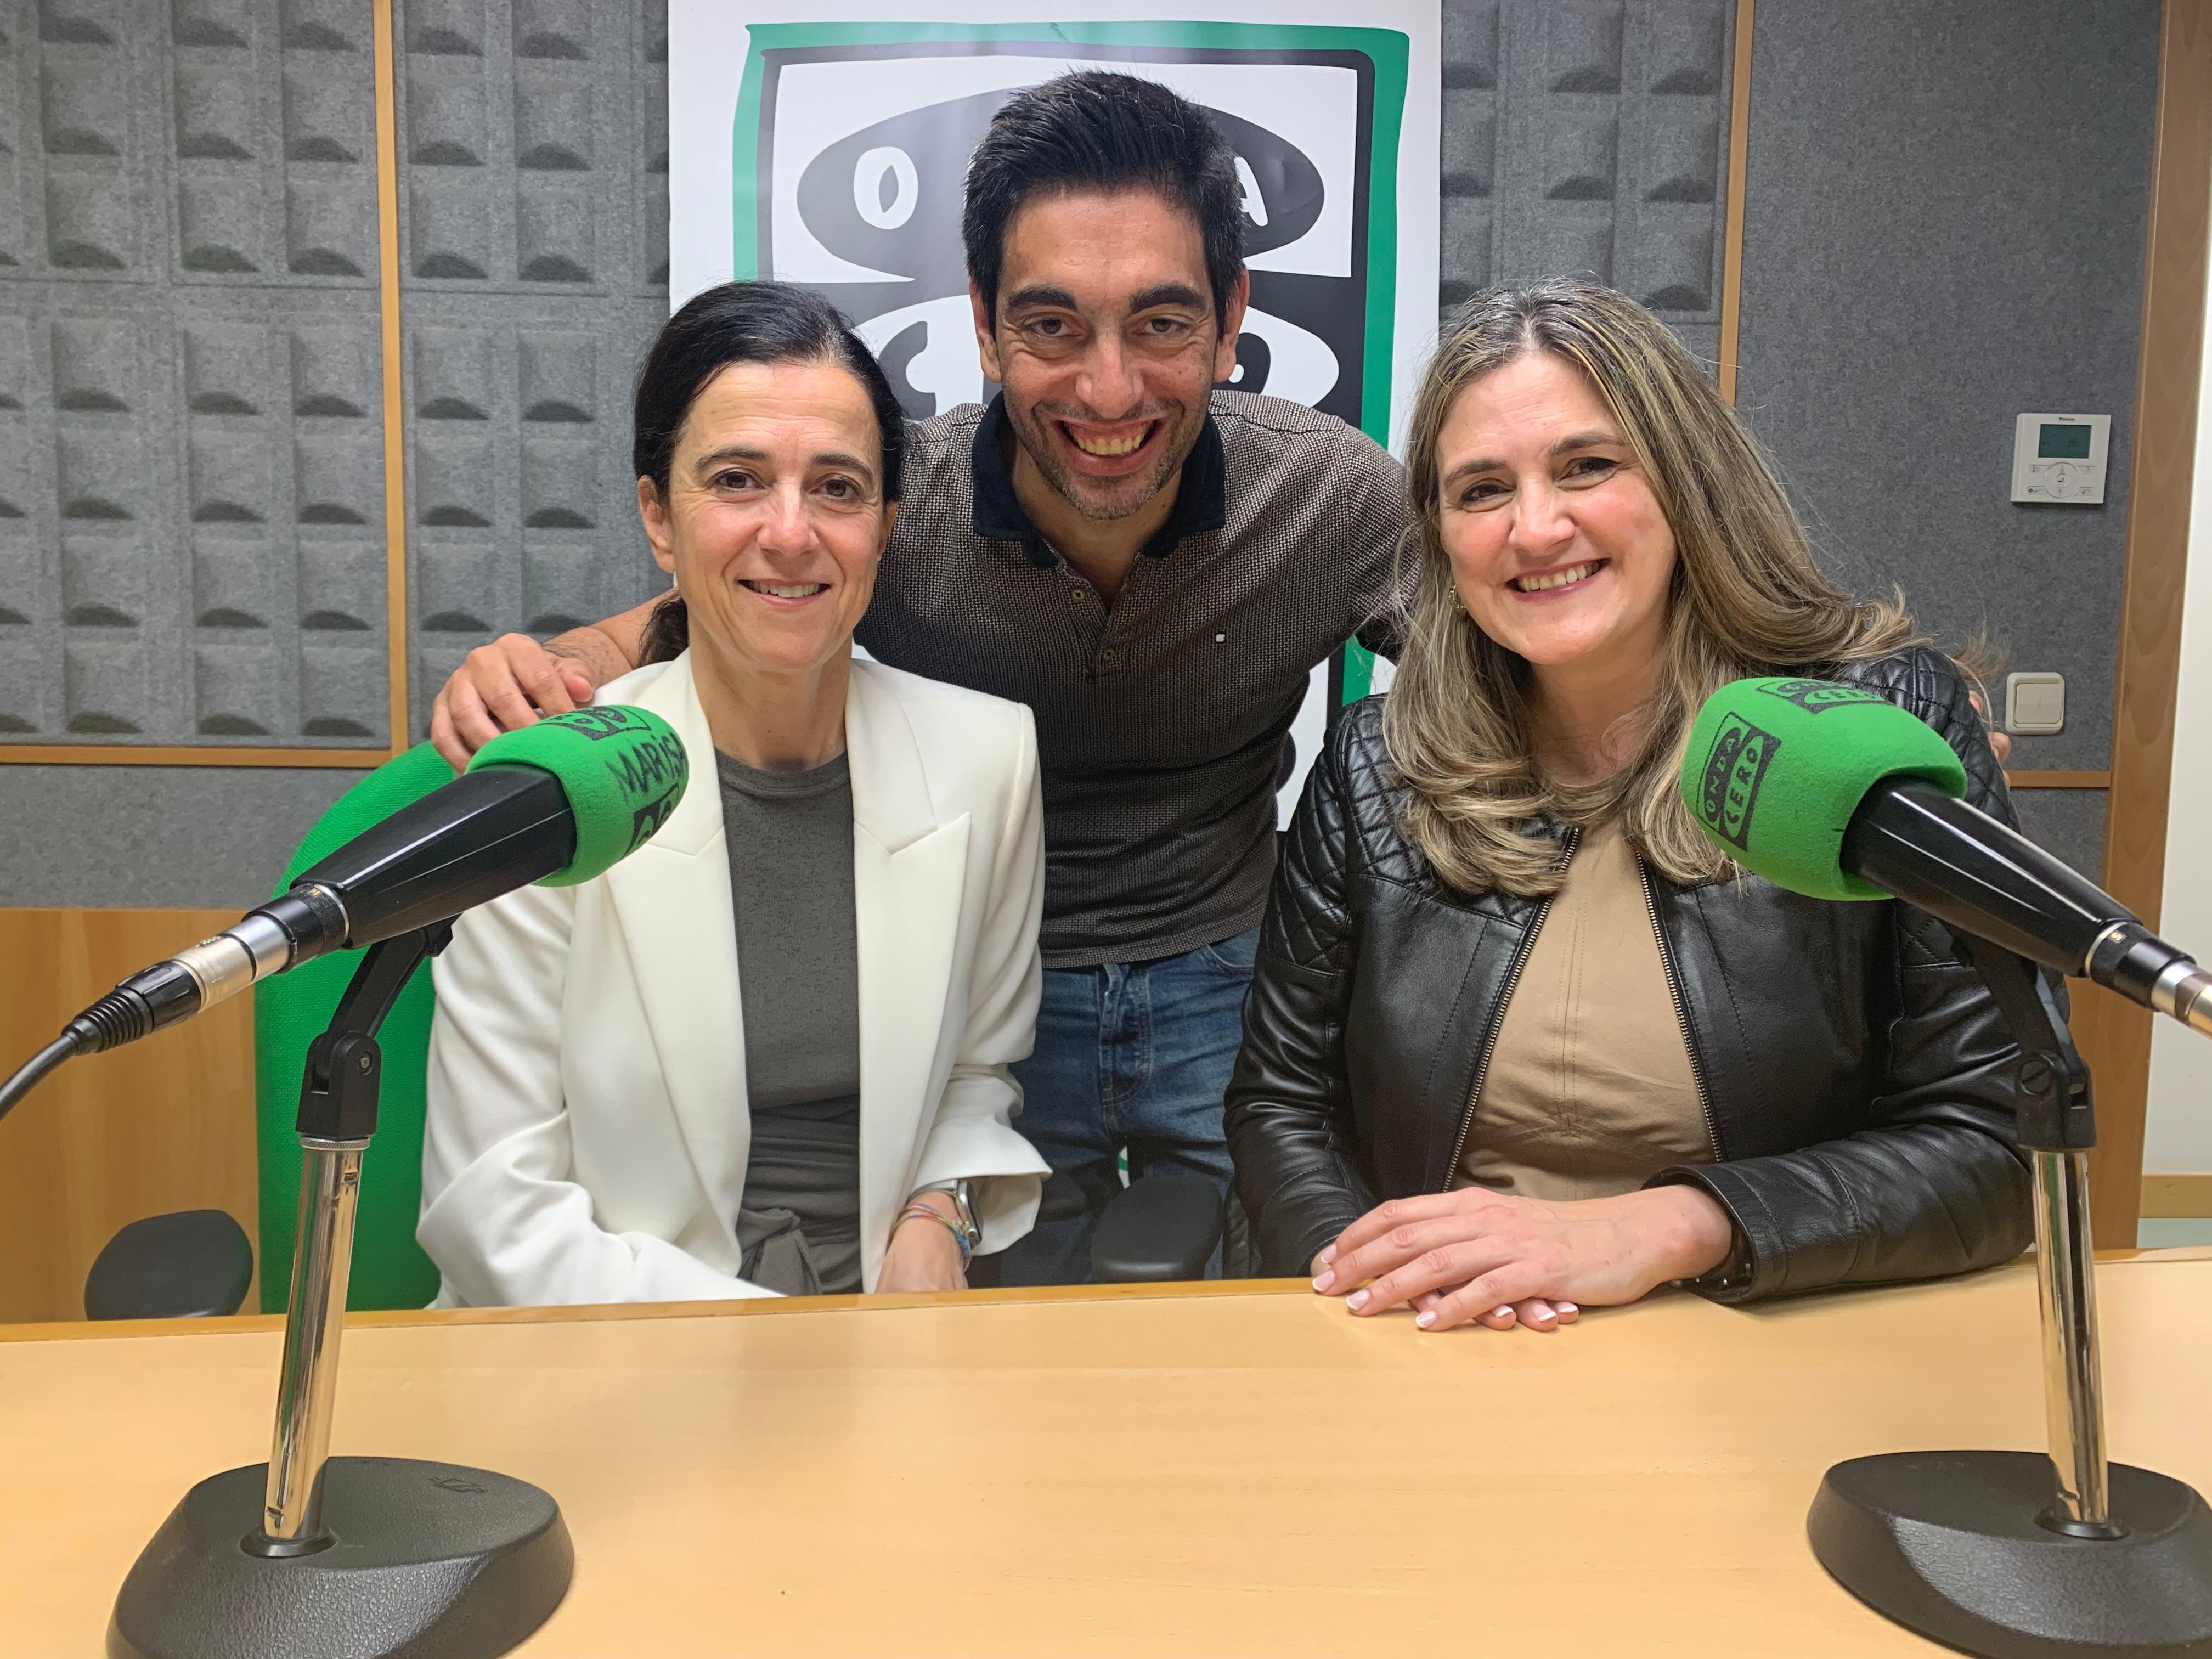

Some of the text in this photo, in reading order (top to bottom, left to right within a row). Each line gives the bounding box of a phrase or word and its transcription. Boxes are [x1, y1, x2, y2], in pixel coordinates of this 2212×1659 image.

[853, 146, 1268, 230] OA
[1706, 737, 1736, 814] ONDA
[1725, 747, 1758, 824] CERO
